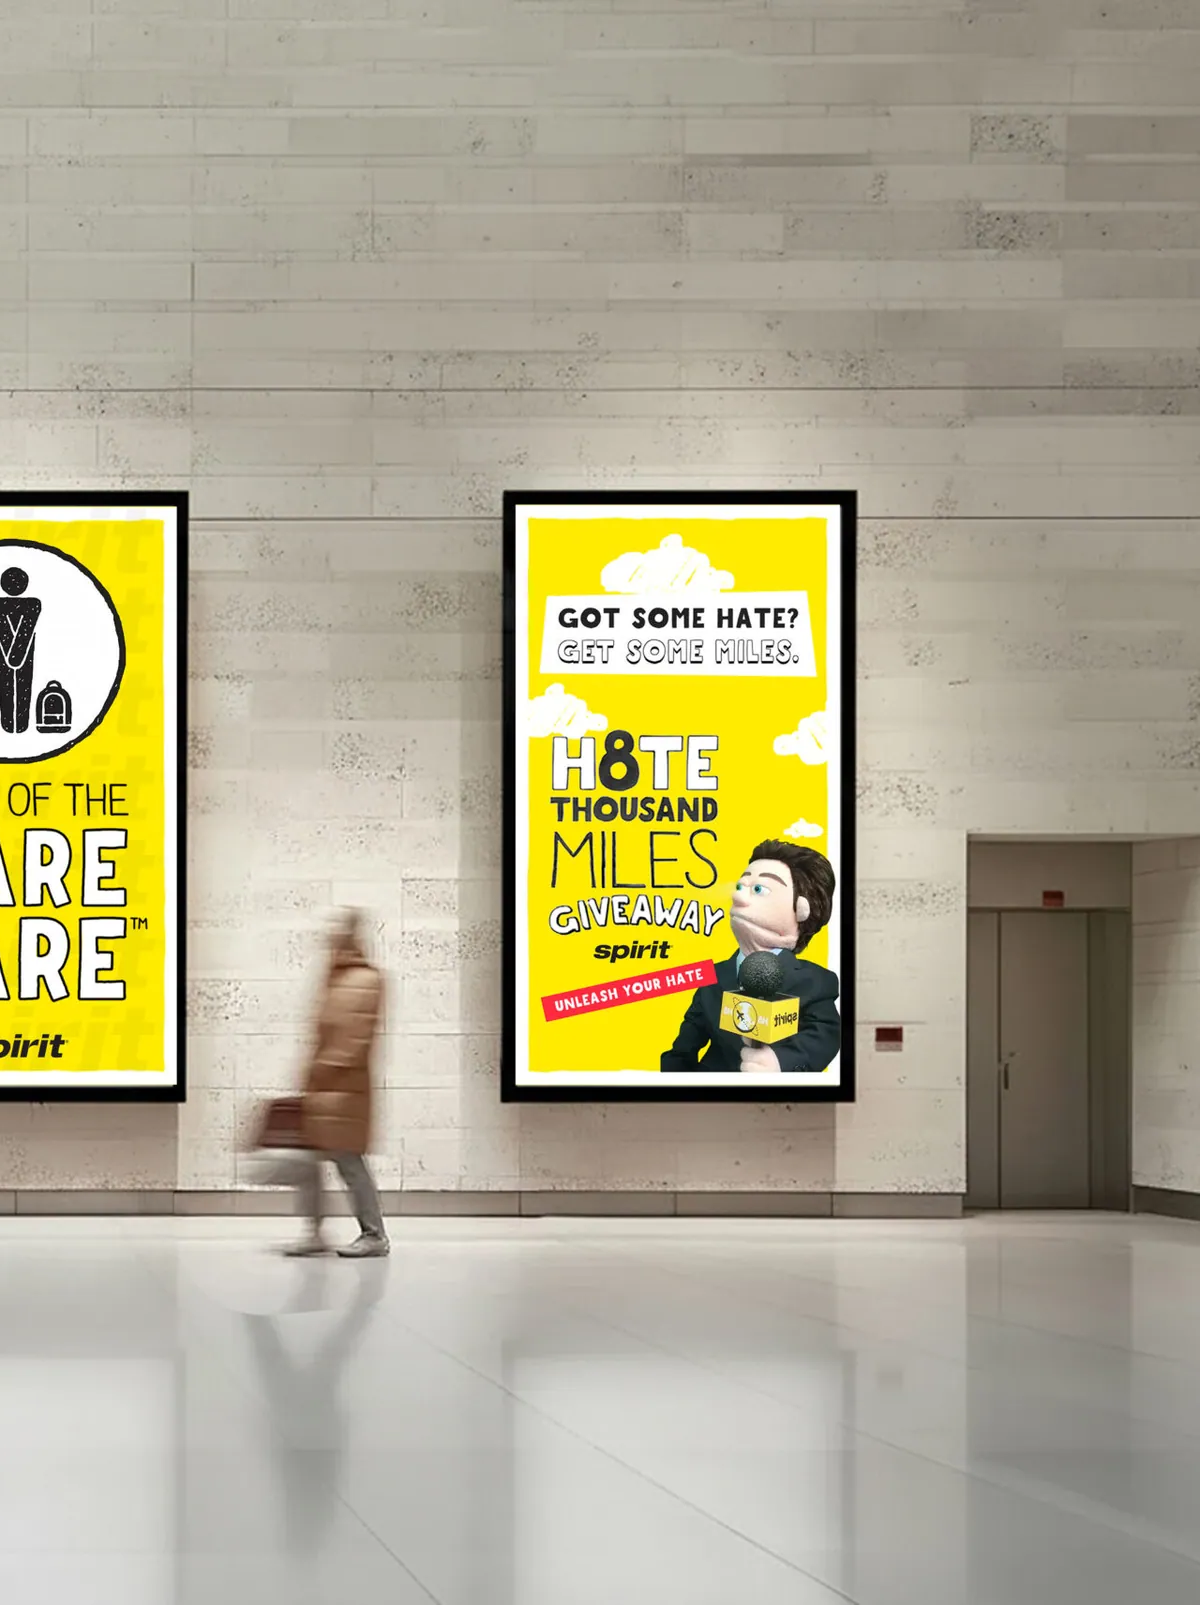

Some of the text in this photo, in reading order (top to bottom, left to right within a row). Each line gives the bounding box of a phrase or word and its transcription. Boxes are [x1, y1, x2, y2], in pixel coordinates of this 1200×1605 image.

[558, 607, 799, 629] GOT SOME HATE?
[557, 639, 799, 665] GET SOME MILES.
[551, 729, 719, 792] H8TE
[7, 782, 52, 816] OF
[63, 783, 129, 816] THE
[550, 796, 718, 823] THOUSAND
[551, 828, 718, 889] MILES
[548, 894, 725, 937] GIVEAWAY
[593, 940, 671, 963] spirit
[554, 967, 704, 1012] UNLEASH YOUR HATE
